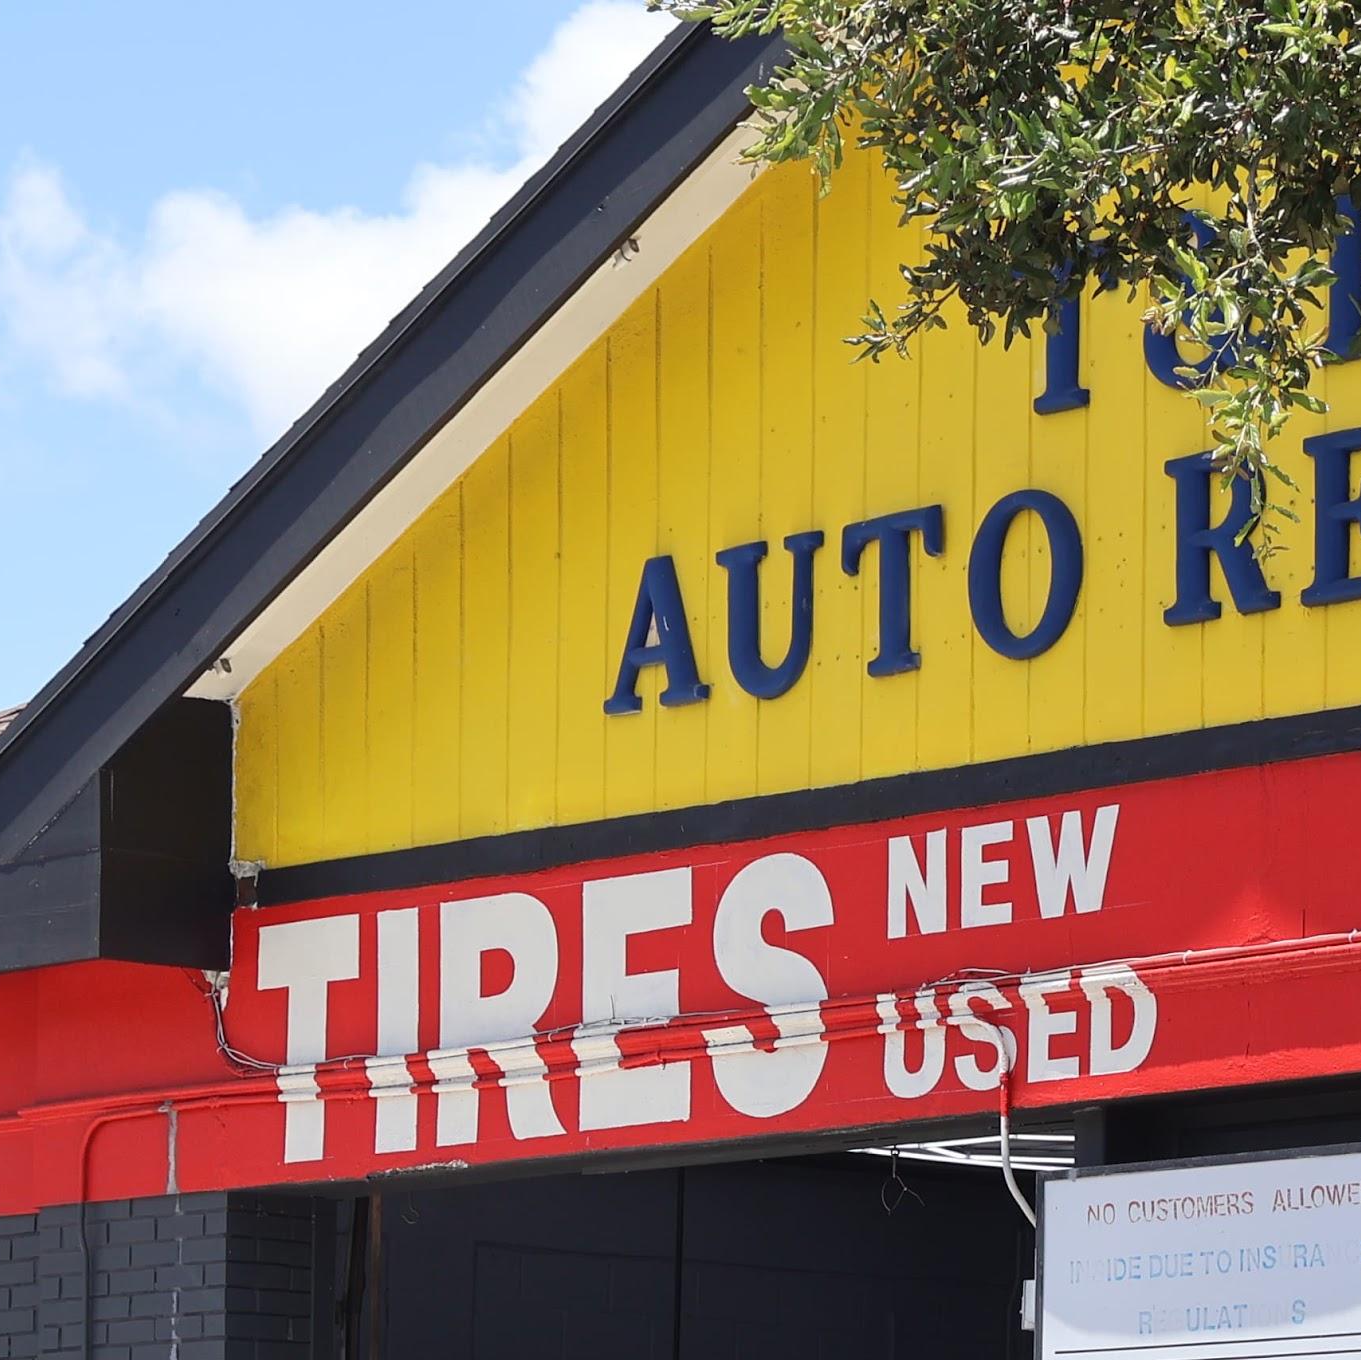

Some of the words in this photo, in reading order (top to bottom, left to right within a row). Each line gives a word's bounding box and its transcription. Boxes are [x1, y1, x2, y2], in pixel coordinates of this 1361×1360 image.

[603, 490, 1083, 716] AUTO
[886, 804, 1120, 939] NEW
[258, 853, 834, 1163] TIRES
[876, 963, 1157, 1100] USED
[1087, 1202, 1116, 1225] NO
[1128, 1191, 1255, 1223] CUSTOMERS
[1149, 1252, 1194, 1279] DUE
[1199, 1249, 1232, 1275] TO
